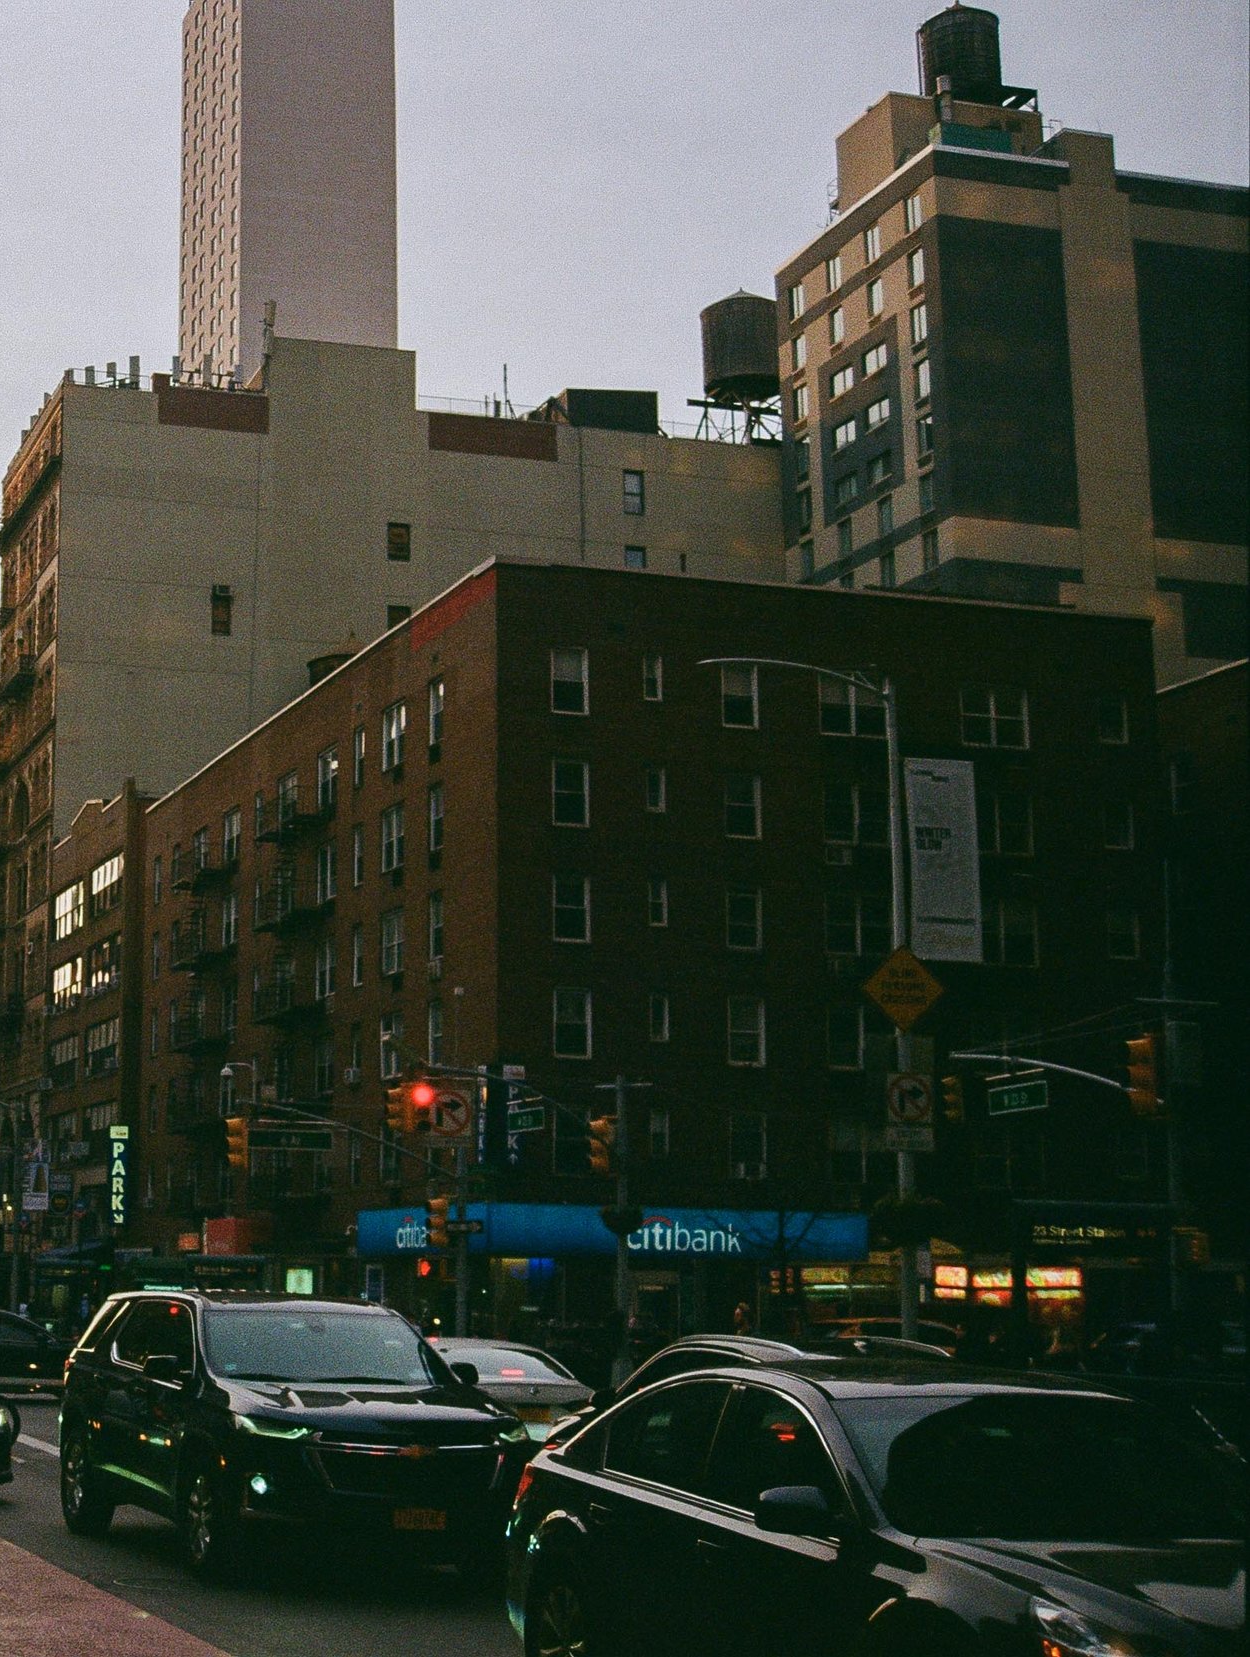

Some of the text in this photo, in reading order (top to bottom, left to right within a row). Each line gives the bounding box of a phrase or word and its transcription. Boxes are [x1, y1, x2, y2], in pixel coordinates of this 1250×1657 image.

[112, 1142, 126, 1211] PARK
[396, 1220, 428, 1249] citiba
[626, 1219, 742, 1253] citibank
[1033, 1225, 1047, 1237] 23
[1050, 1225, 1084, 1238] Street
[1087, 1225, 1126, 1238] Station
